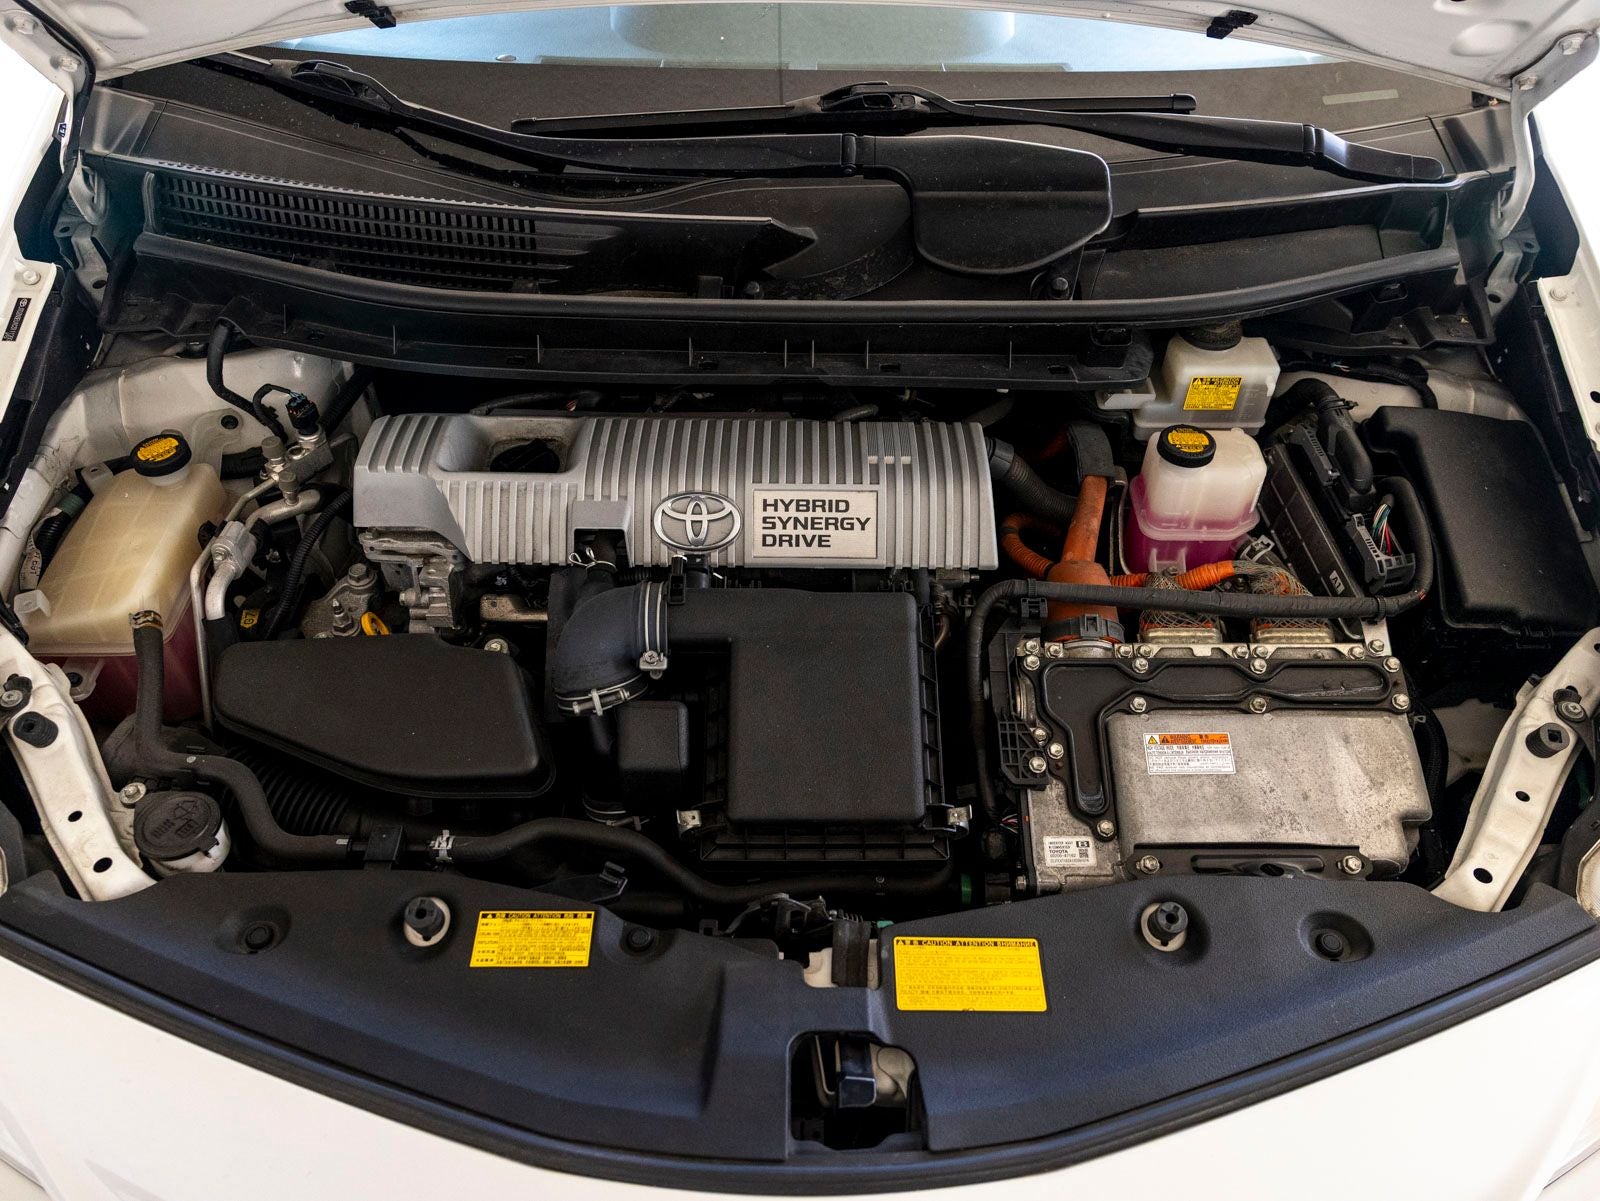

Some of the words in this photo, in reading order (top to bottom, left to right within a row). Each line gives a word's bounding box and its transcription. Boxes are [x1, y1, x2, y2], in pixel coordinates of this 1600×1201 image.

[762, 498, 850, 513] HYBRID
[761, 516, 872, 531] SYNERGY
[761, 534, 832, 548] DRIVE
